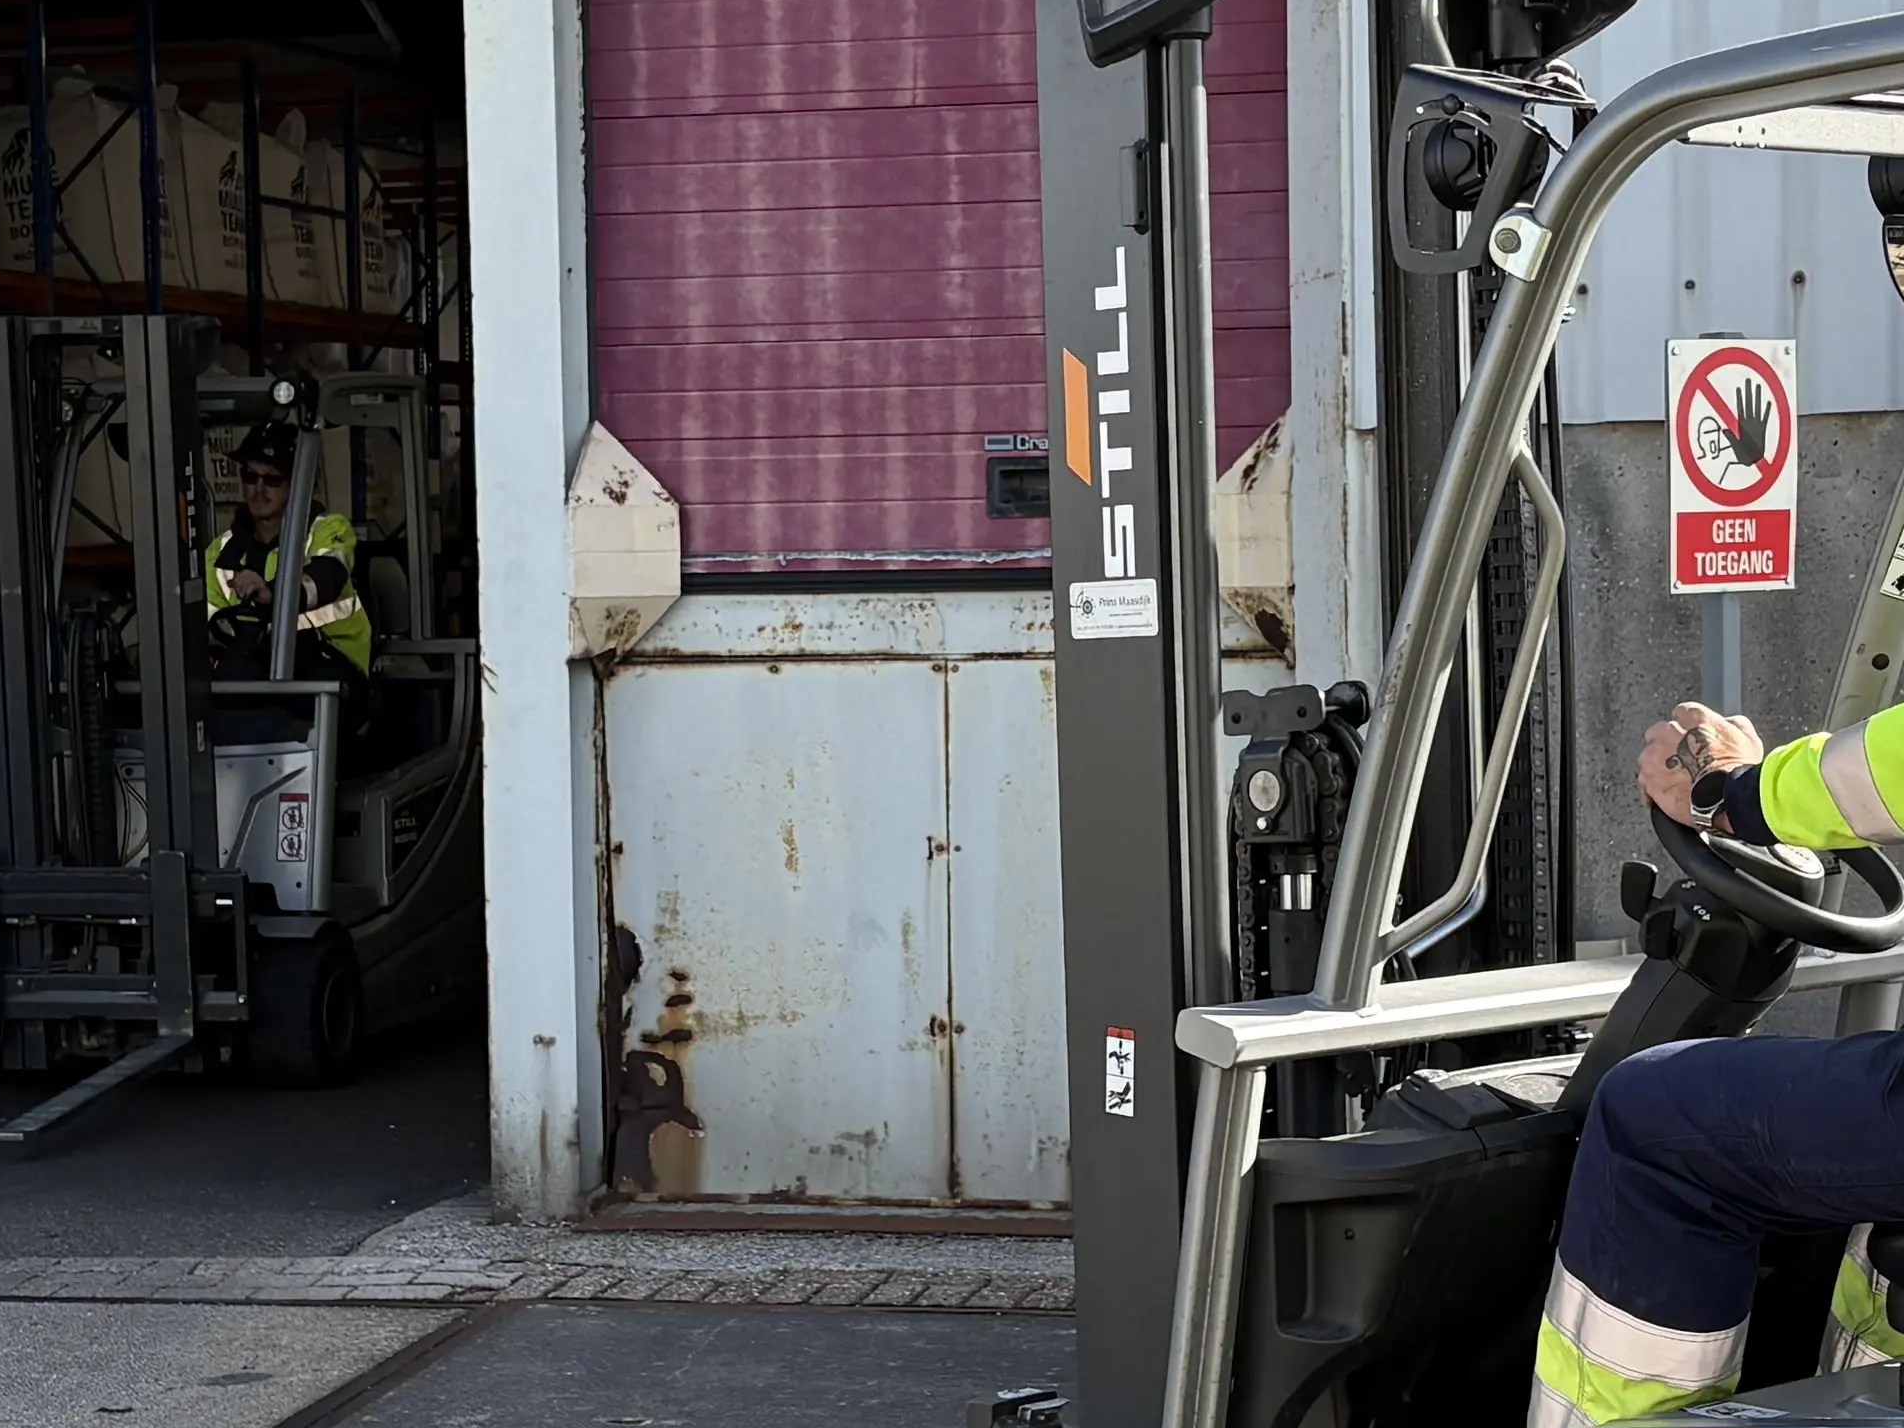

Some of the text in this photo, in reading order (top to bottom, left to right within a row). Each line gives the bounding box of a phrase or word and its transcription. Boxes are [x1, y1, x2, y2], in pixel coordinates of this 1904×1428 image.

[3, 169, 59, 200] MUE
[1095, 246, 1136, 577] STILL
[1712, 518, 1756, 544] GEEN
[1694, 549, 1773, 577] TOEGANG
